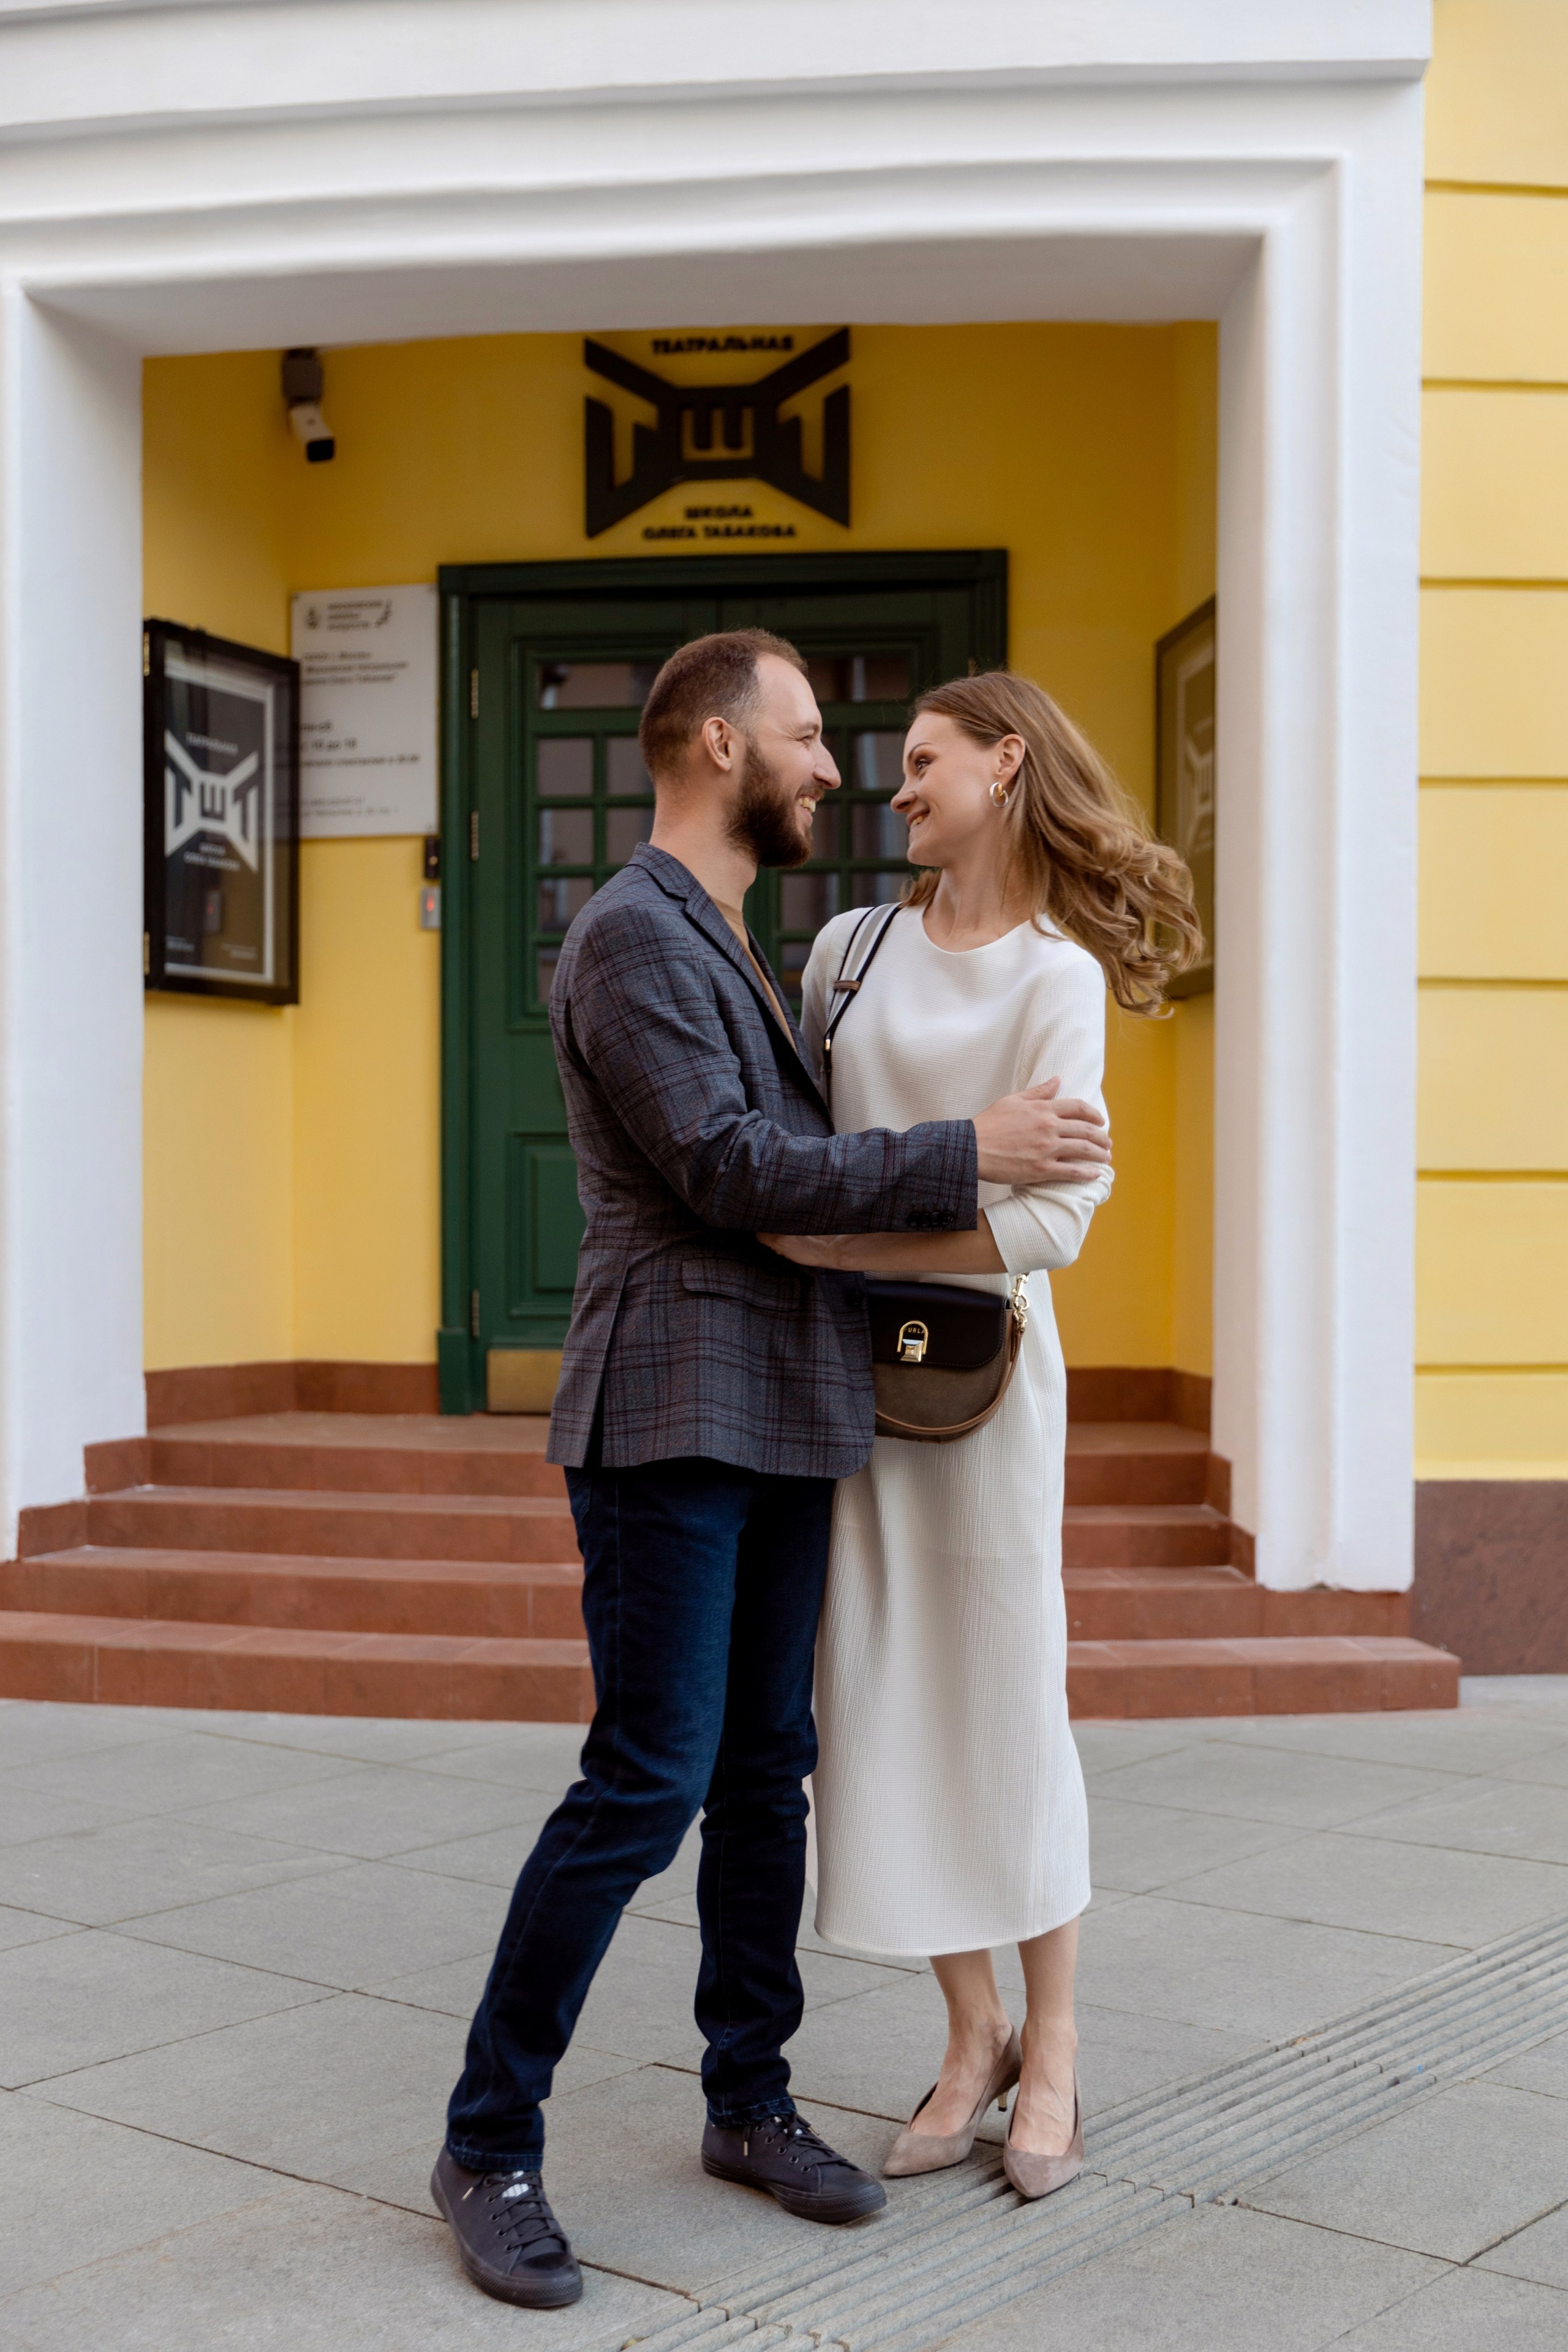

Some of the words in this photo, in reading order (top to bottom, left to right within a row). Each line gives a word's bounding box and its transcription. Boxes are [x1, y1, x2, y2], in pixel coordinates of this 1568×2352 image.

[653, 335, 793, 353] ТЕАТРАЛЬНАЯ
[685, 505, 753, 519] ШКОЛА
[703, 524, 796, 538] ТАБАКОВА
